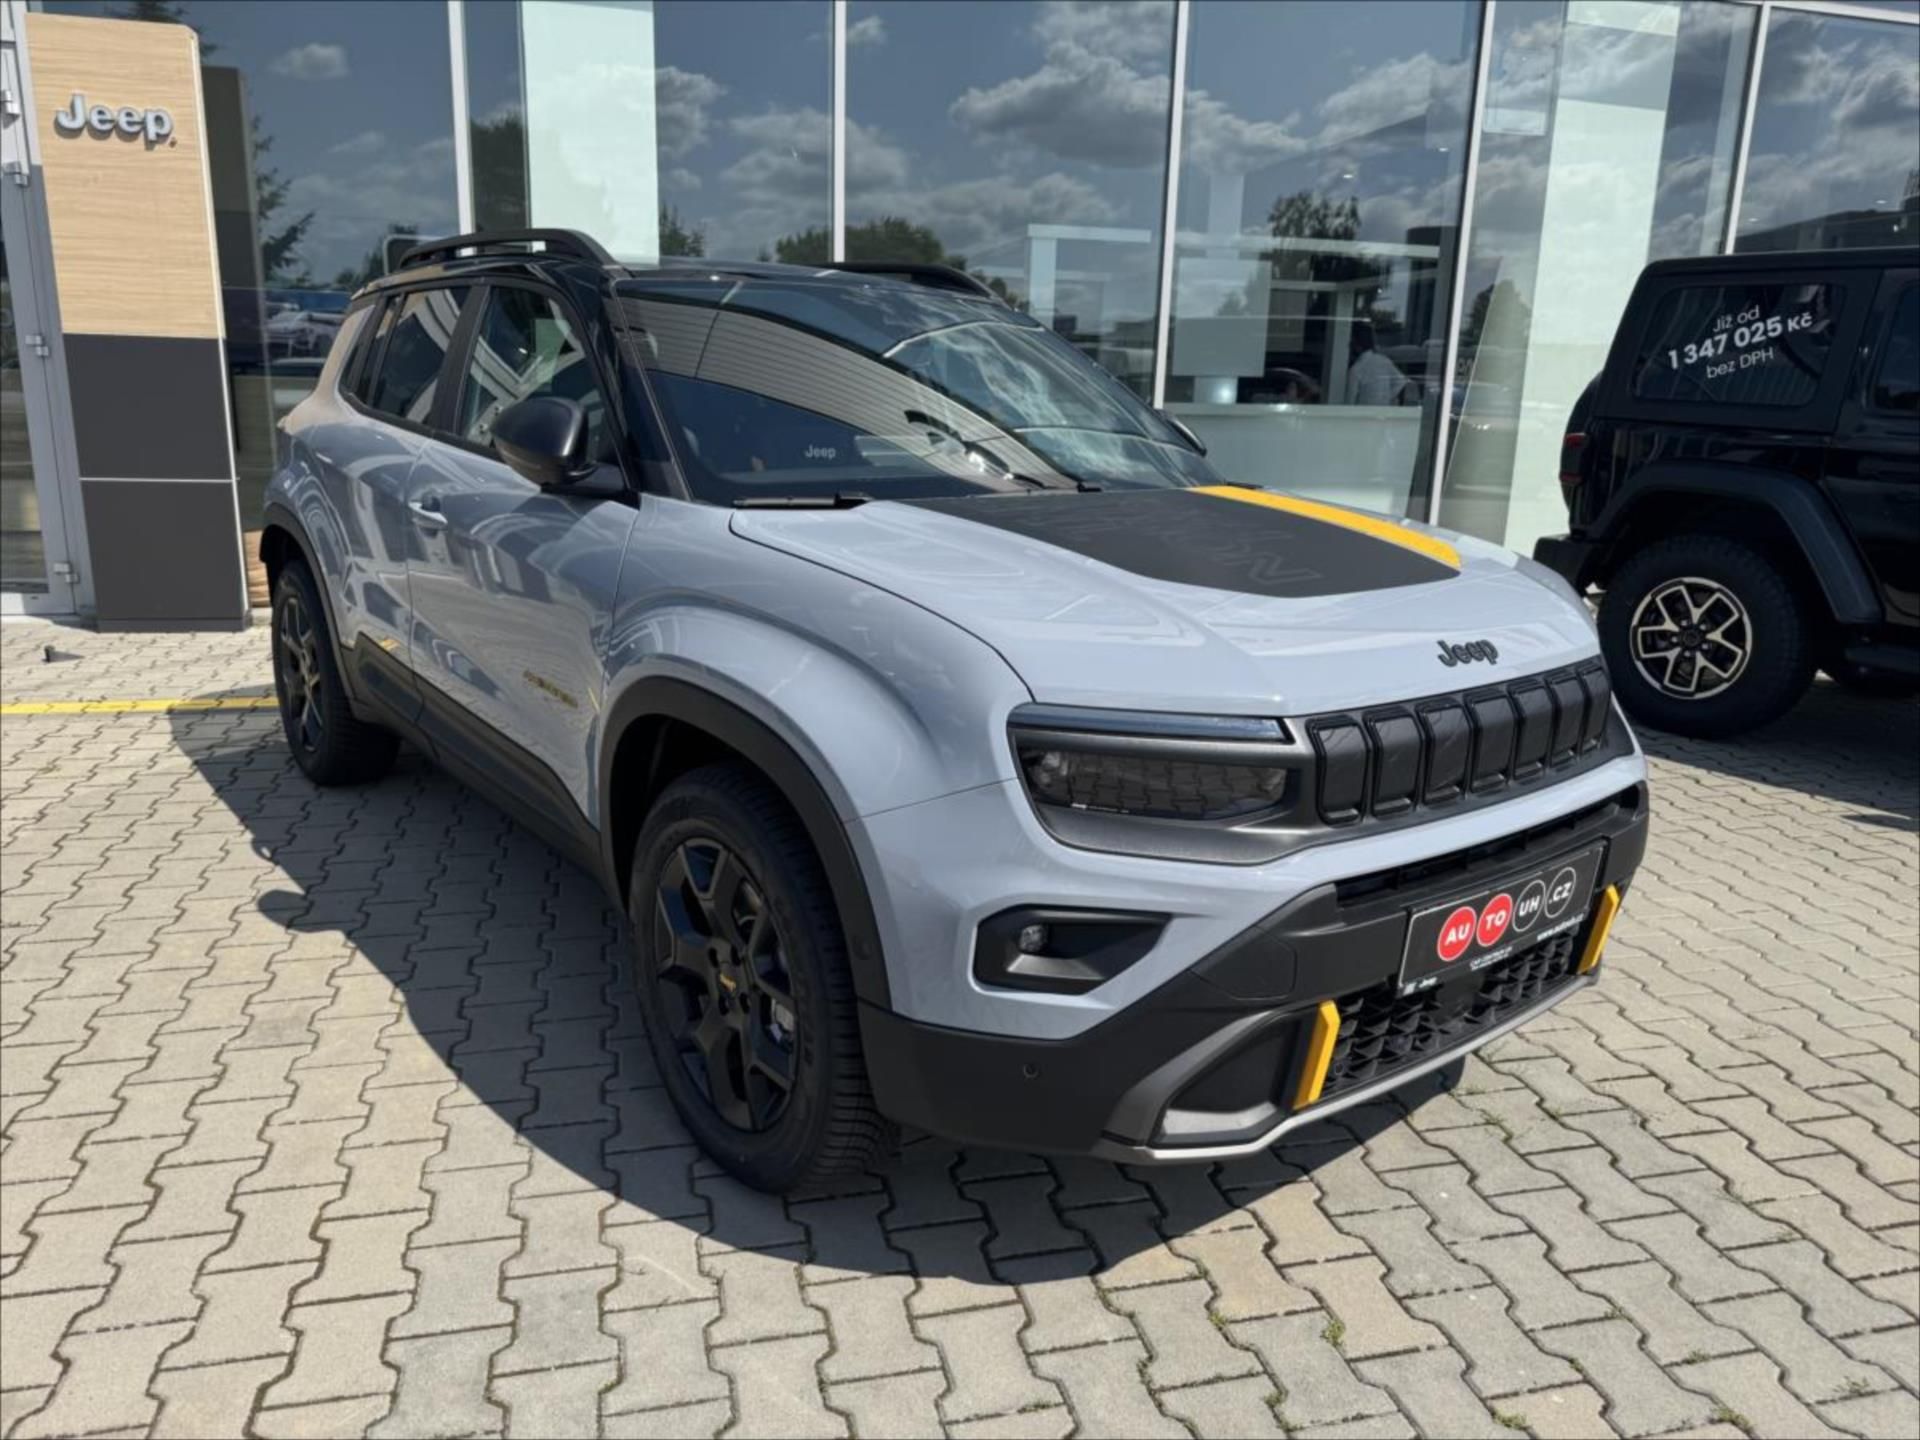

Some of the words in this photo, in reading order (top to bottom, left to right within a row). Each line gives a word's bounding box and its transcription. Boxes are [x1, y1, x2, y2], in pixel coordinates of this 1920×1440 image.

[55, 92, 174, 143] Jeep
[1712, 314, 1734, 333] Již
[1737, 304, 1760, 324] od
[1668, 349, 1679, 370] 1
[1683, 333, 1728, 364] 347
[1734, 316, 1783, 348] 025
[1787, 312, 1813, 332] Kč
[1706, 360, 1736, 379] bez
[1739, 347, 1775, 369] DPH
[804, 444, 836, 460] Jeep
[1436, 639, 1499, 668] Jeep
